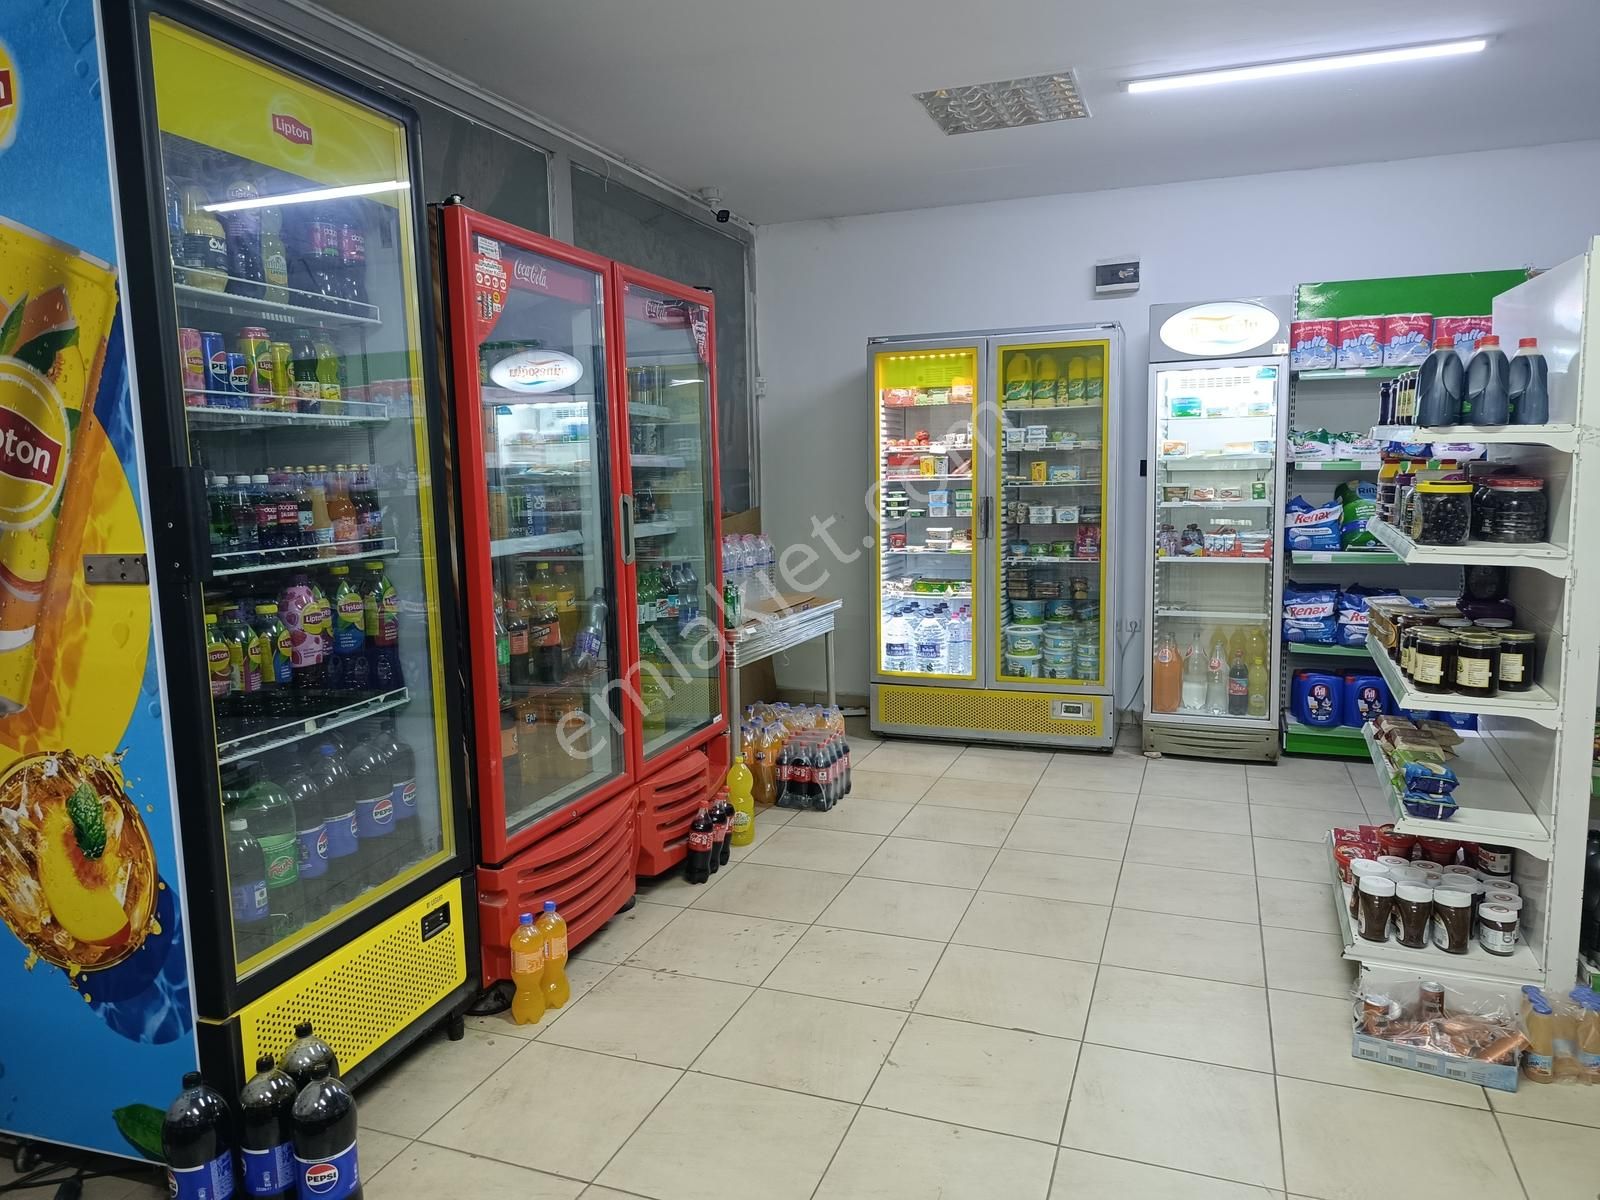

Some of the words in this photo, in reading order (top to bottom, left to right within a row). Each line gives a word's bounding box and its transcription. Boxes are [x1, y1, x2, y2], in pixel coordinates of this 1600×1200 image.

[275, 117, 309, 141] Lipton
[514, 259, 547, 287] Coca-Cola
[1295, 511, 1332, 525] Renax
[1290, 606, 1328, 619] Renax
[1350, 611, 1368, 622] Re
[1314, 685, 1326, 697] Pril
[1364, 687, 1376, 699] Pril
[307, 1172, 337, 1183] PEPSI
